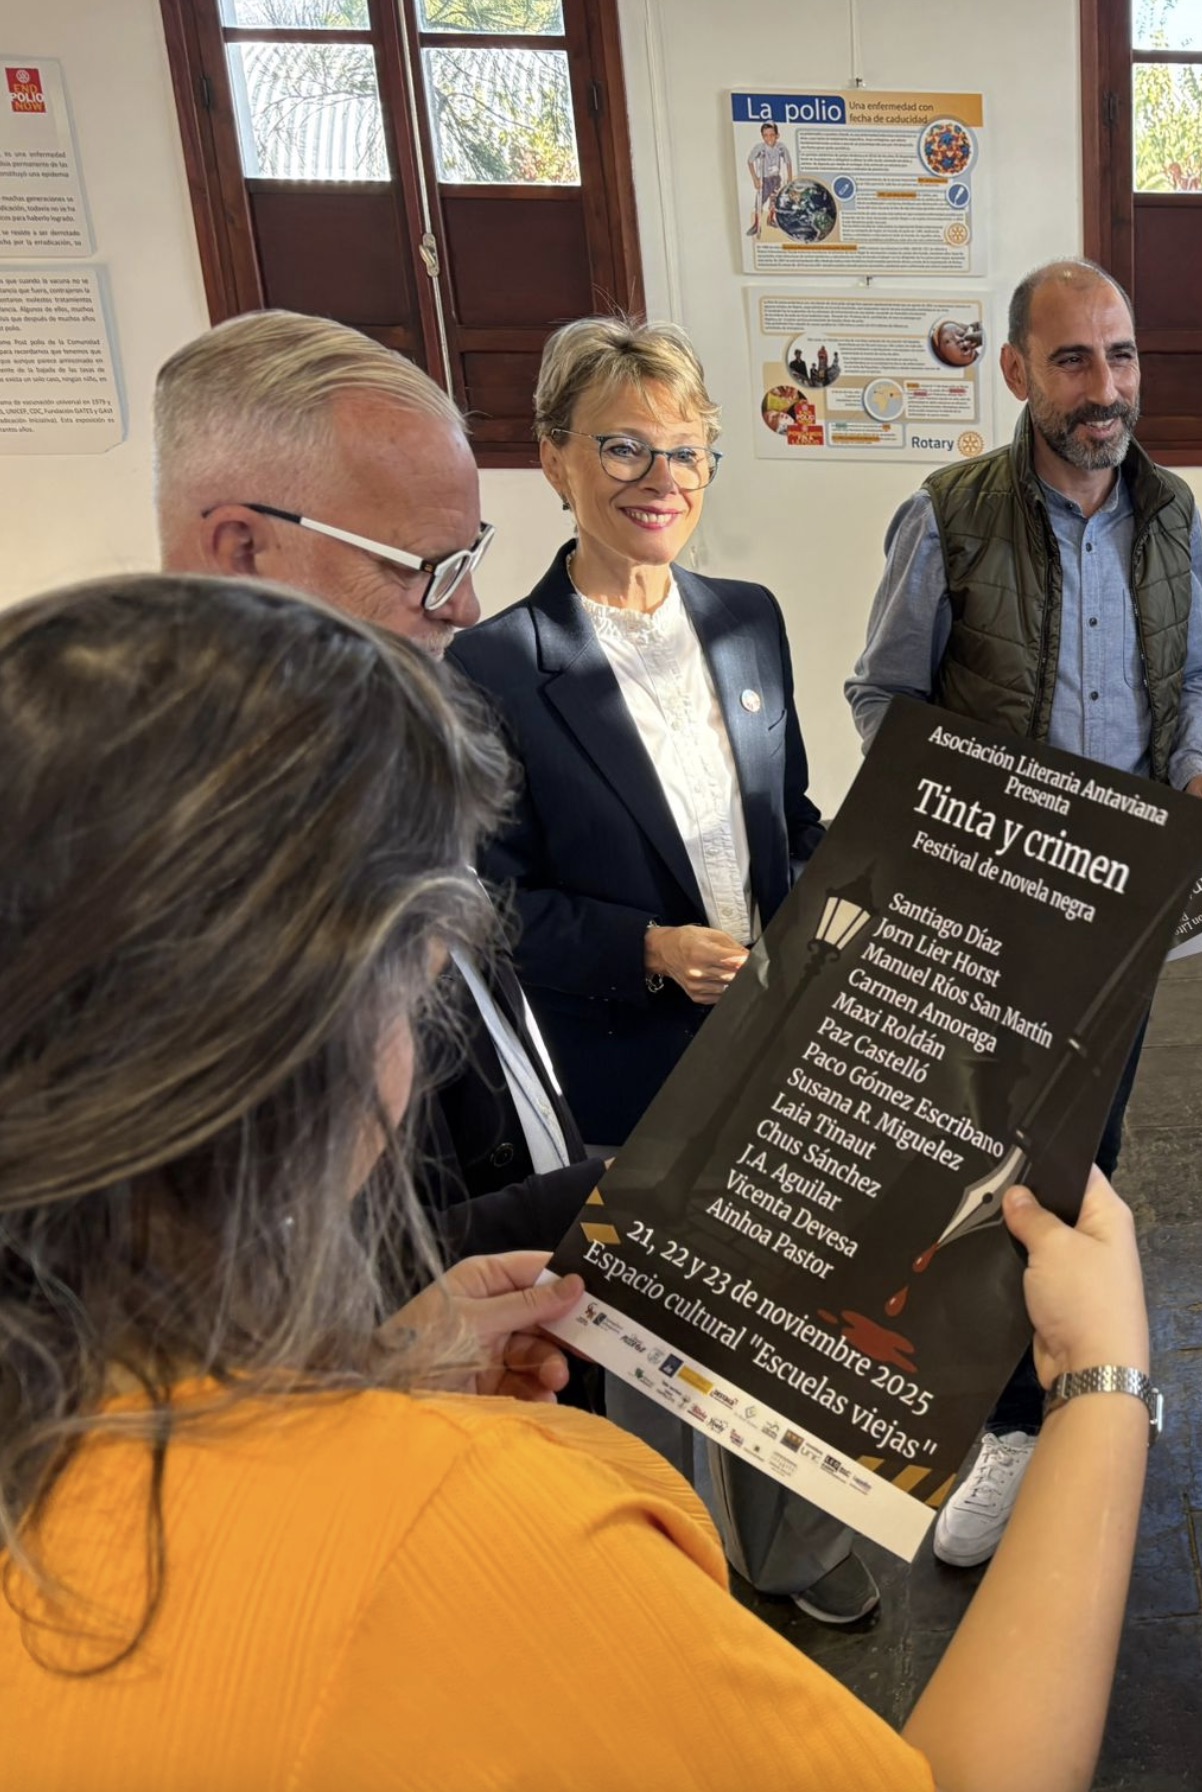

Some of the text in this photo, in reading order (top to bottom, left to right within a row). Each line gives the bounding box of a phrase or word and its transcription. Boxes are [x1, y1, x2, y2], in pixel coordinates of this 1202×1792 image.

[10, 92, 44, 102] POLIO
[14, 83, 37, 94] END
[15, 101, 43, 111] NOW
[746, 97, 842, 124] La polio
[849, 101, 934, 112] Una enfermedad con
[850, 113, 928, 125] fecha de caducidad
[911, 436, 954, 451] Rotary
[928, 725, 1169, 826] Asociación Literaria Antaviana
[1004, 775, 1071, 816] Presenta
[913, 778, 1130, 894] Tinta y crimen
[912, 830, 1096, 923] Festival de novela negra
[872, 917, 1001, 988] Jørn Lier Horst
[888, 892, 1003, 956] Santiago Díaz
[831, 991, 946, 1061] Maxi Roldán
[848, 968, 997, 1053] Carmen Amoraga
[860, 942, 1053, 1049] Manuel Ríos San Martín
[817, 1016, 930, 1083] Paz Castelló
[771, 1092, 877, 1160] Laia Tinaut
[786, 1067, 964, 1171] Susana R. Miguelez
[801, 1041, 1004, 1158] Paco Gómez Escribano
[736, 1143, 843, 1211] J.A. Aguilar
[756, 1119, 882, 1198] Chus Sánchez
[705, 1197, 835, 1279] Ainhoa Pastor
[727, 1168, 858, 1258] Vicenta Devesa
[583, 1239, 665, 1300] Espacio
[664, 1293, 747, 1351] cultural
[749, 1333, 849, 1415] "Escuelas
[851, 1404, 938, 1459] viejas"
[626, 1220, 934, 1416] 21, 22 y 23 de noviembre 2025
